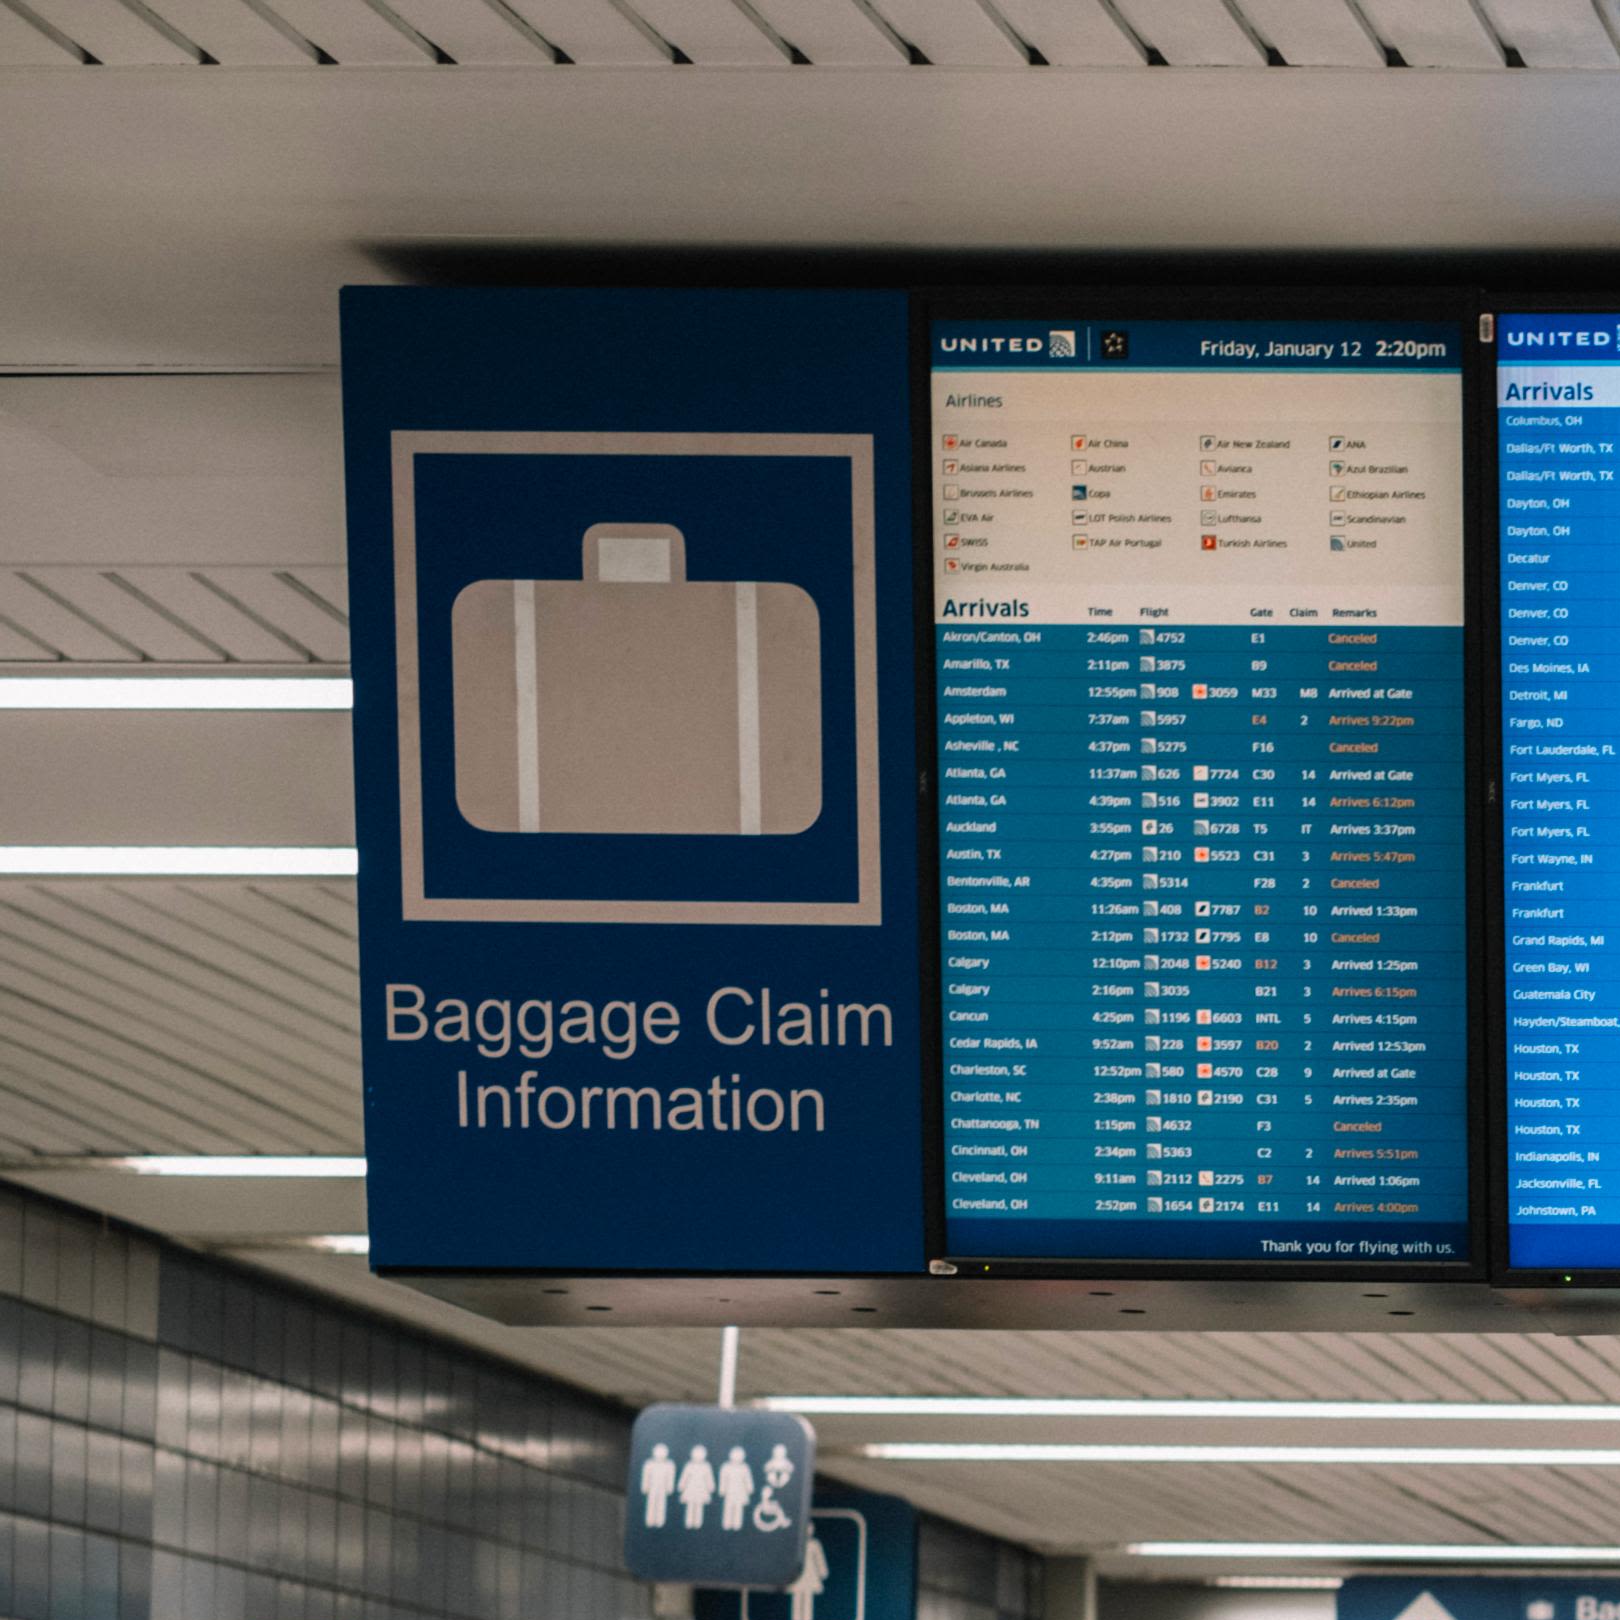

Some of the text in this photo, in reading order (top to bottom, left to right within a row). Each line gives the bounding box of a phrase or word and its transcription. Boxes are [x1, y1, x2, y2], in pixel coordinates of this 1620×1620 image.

[941, 338, 1043, 352] UNITED
[1508, 332, 1610, 346] UNITED
[1201, 341, 1445, 359] Friday, January 12 2:20pm
[1505, 382, 1593, 401] Arrivals
[945, 394, 1003, 408] Airlines
[1088, 440, 1129, 448] Air China
[1346, 441, 1366, 449] ANA
[1217, 490, 1256, 499] Emirates
[1217, 515, 1262, 523] Lufthansa
[1346, 515, 1406, 524] Scandinavian
[1347, 540, 1377, 548] United
[942, 598, 1377, 618] Arrivals Time Flight Gate Claim Remarks
[943, 631, 1377, 644] Akron/Canton, OH 2:46pm 4752 E1 Canceled
[1512, 908, 1564, 918] Frankfurt
[386, 984, 892, 1059] Baggage Claim
[459, 1071, 824, 1131] Information
[1261, 1240, 1454, 1255] Thank you for flying with us.
